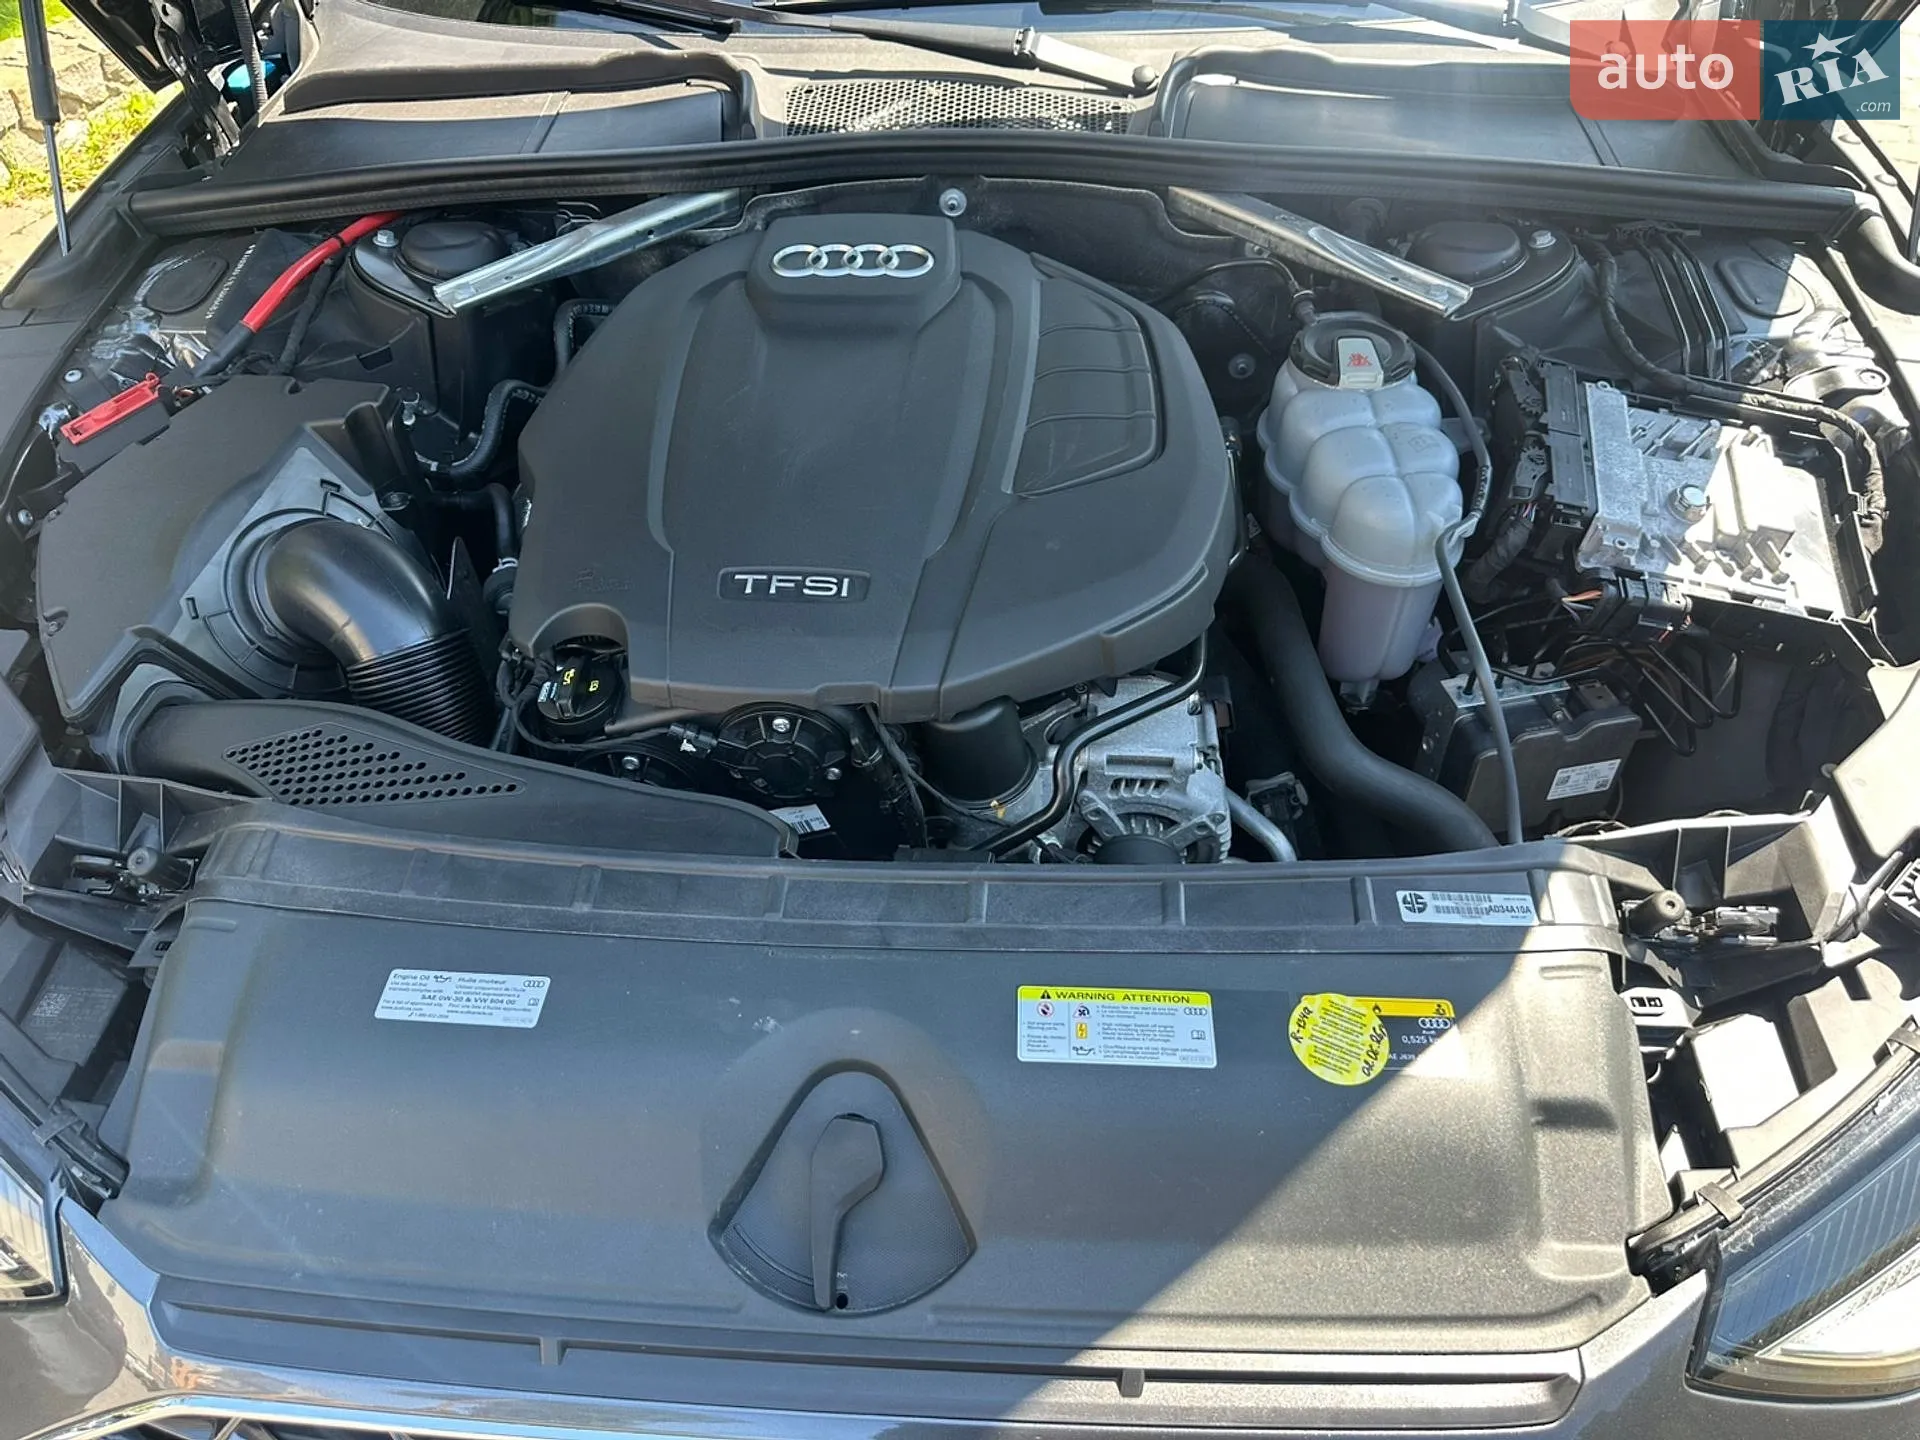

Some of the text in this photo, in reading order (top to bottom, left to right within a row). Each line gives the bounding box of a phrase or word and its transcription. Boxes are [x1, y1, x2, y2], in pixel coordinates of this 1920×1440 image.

[734, 574, 850, 597] TFSI
[393, 973, 418, 981] Engine
[1055, 991, 1190, 1004] WARNING ATTENTION
[1401, 1034, 1428, 1044] 0,525
